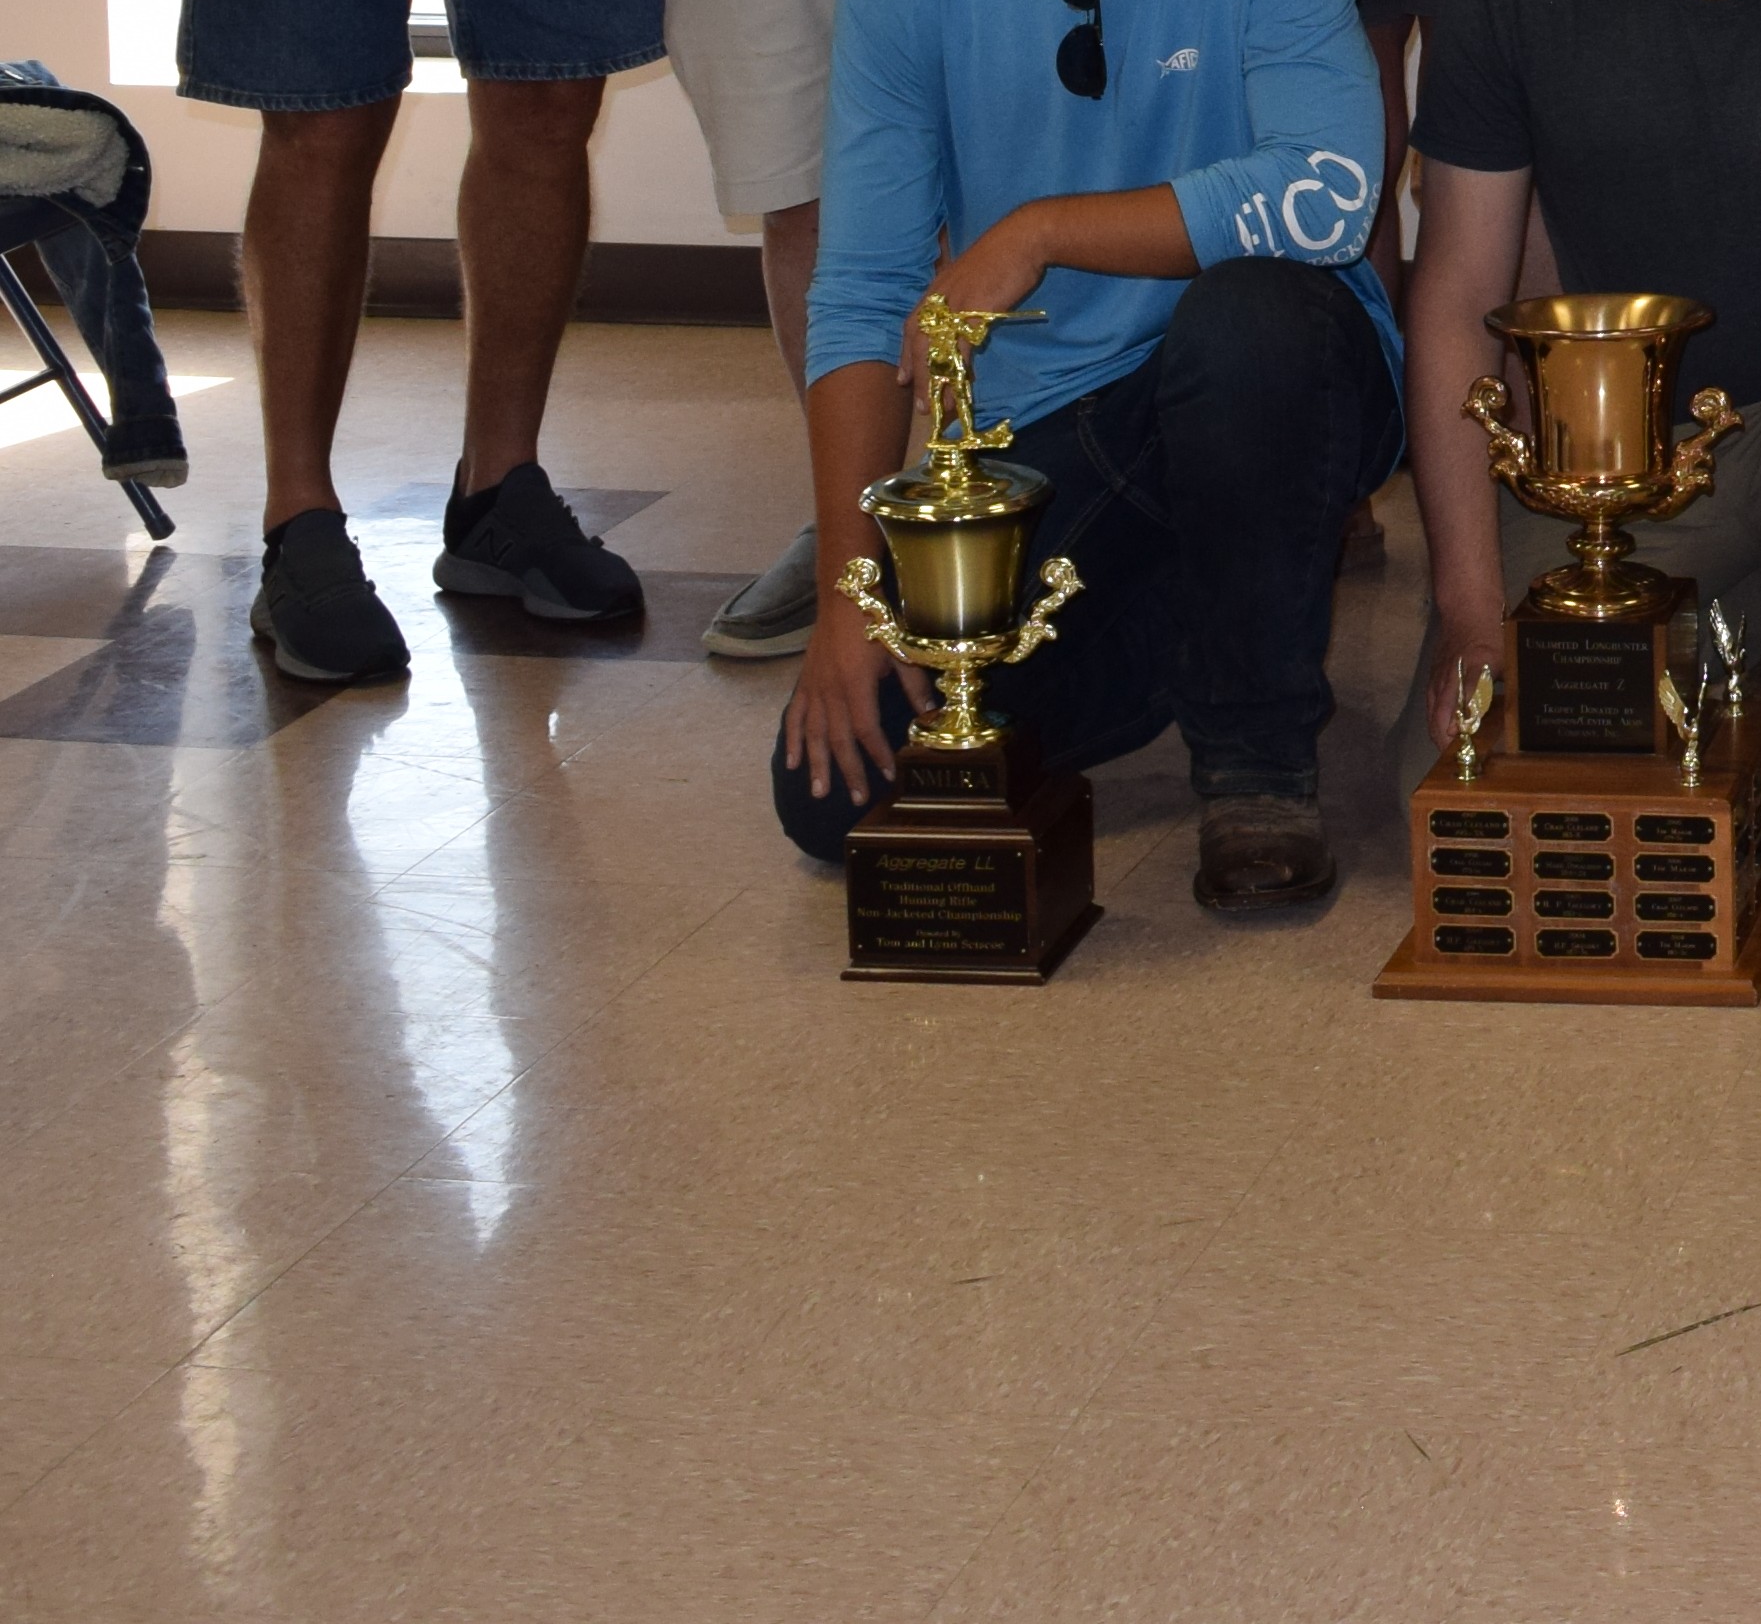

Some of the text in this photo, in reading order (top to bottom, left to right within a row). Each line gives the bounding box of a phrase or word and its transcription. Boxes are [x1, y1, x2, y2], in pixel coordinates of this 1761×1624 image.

[1526, 637, 1649, 652] UNLIMITED LONGHUNTER
[1552, 652, 1622, 665] CHAMPIONSHIP
[1552, 679, 1625, 691] AGGREGATE Z
[1580, 704, 1619, 715] DONATED
[911, 768, 991, 790] NMLRA
[876, 854, 995, 872] Aggregate LL
[880, 880, 995, 893] Traditional Offhand
[899, 895, 977, 907] Hunting Rifle
[856, 907, 1023, 922] Non-Jacketed Championship
[916, 929, 949, 938] Donated
[876, 936, 901, 948] Tom
[905, 938, 926, 949] and
[929, 938, 958, 950] Lynn
